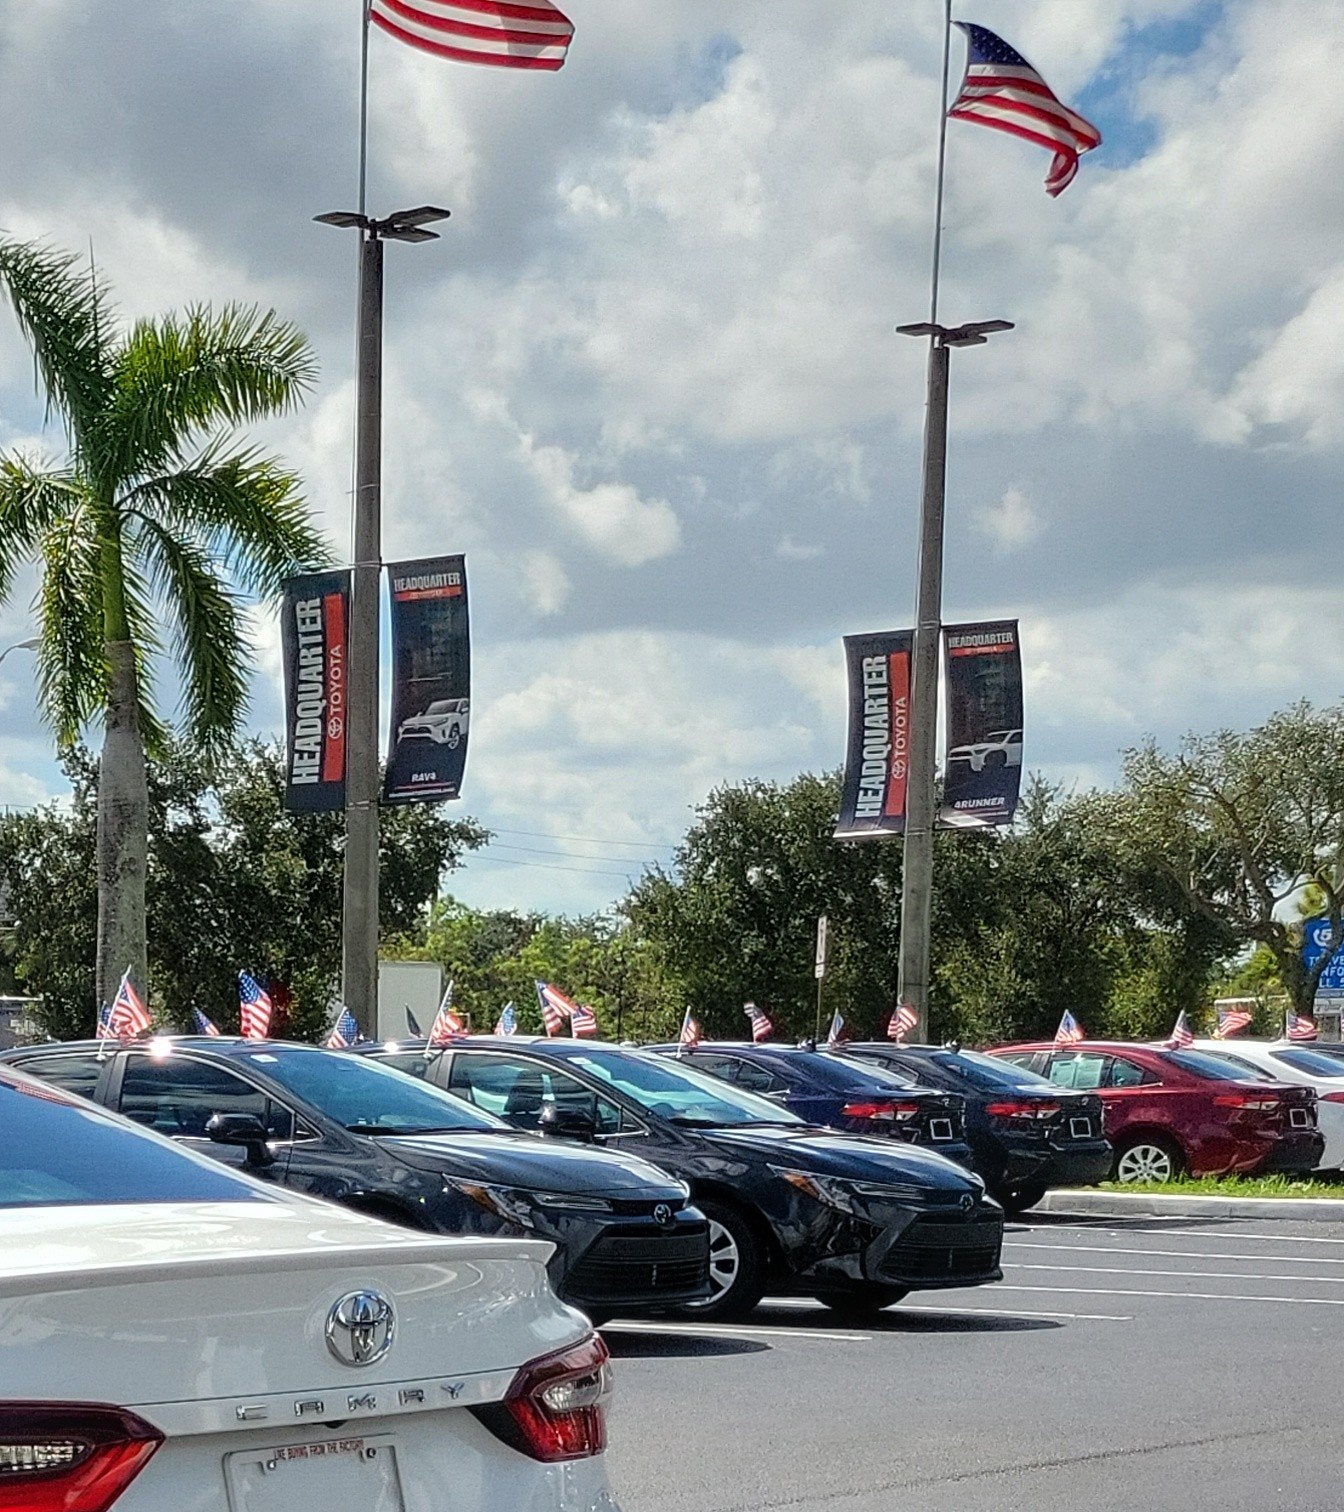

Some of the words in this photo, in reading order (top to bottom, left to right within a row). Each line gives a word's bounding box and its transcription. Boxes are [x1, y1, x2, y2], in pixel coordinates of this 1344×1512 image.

[394, 572, 461, 592] HEADQUARTER
[948, 632, 1013, 648] HEADQUARTER
[292, 598, 326, 785] HEADQUARTER
[329, 645, 342, 716] TOYOTA
[855, 654, 891, 818] HEADQUARTER
[895, 697, 906, 757] TOYOTA
[954, 797, 1005, 808] 4RUNNER
[236, 1383, 465, 1420] CAMRY
